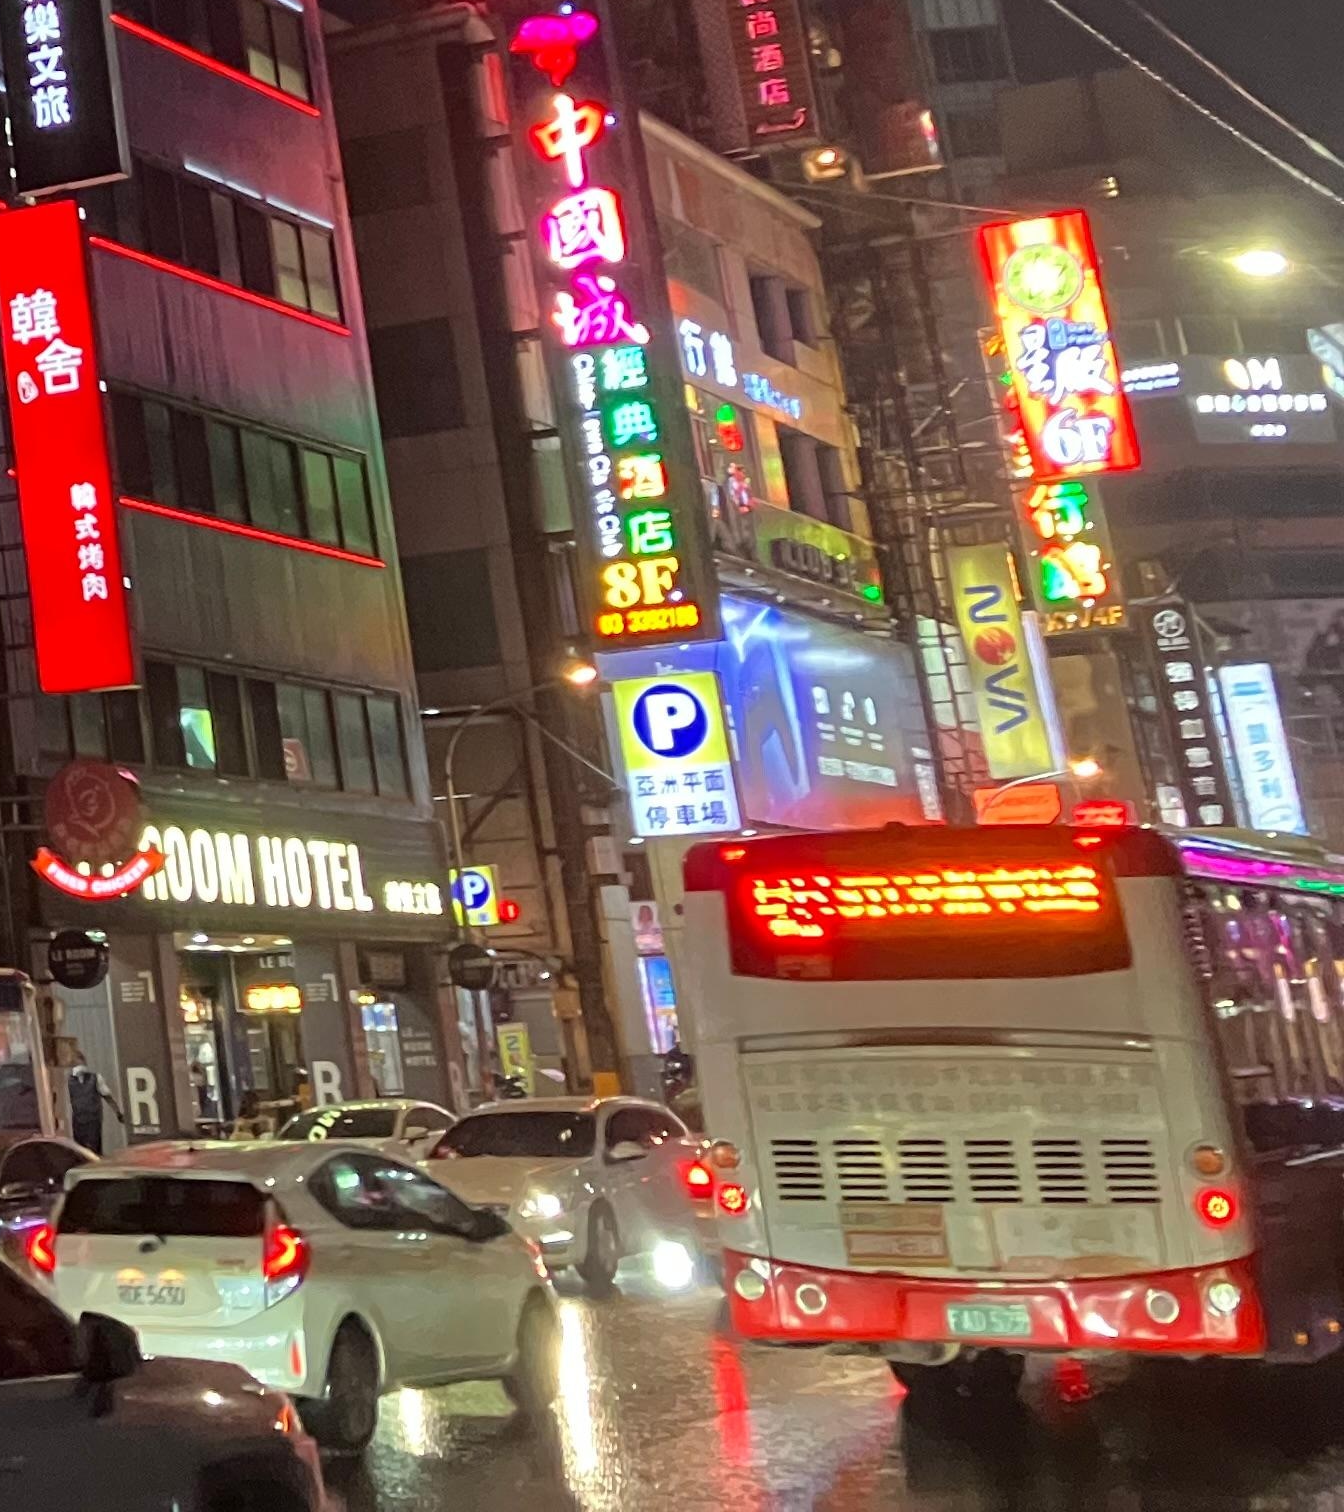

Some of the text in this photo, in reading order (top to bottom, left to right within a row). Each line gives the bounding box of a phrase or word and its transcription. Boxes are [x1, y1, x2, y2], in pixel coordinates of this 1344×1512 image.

[526, 92, 652, 349] 中國城
[9, 288, 84, 397] 韓舍
[601, 345, 674, 558] 經典酒店
[1040, 408, 1116, 465] 6F
[69, 480, 110, 603] 韓式烤肉
[603, 556, 679, 609] 8F
[963, 584, 1031, 735] NOVA
[644, 692, 696, 752] P
[636, 766, 726, 797] 亞洲平面
[644, 803, 729, 829] 停車場
[258, 834, 375, 913] HOTEL
[463, 874, 486, 907] P
[127, 1066, 160, 1126] R
[311, 1059, 345, 1108] R
